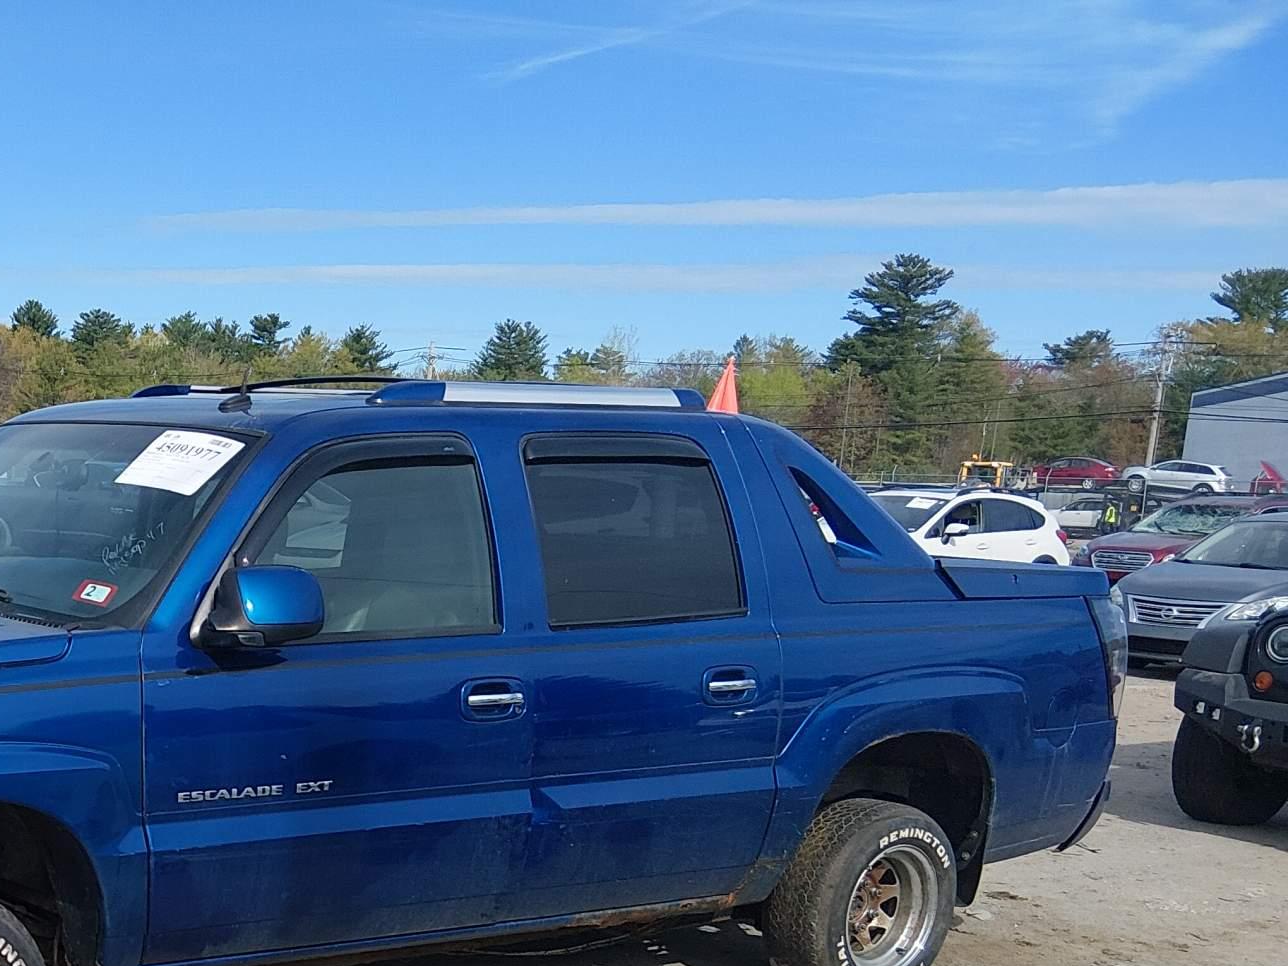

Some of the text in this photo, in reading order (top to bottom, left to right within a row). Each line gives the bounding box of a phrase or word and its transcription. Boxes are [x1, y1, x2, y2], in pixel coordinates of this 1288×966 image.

[178, 780, 333, 803] ESCALADE EXT
[879, 827, 951, 869] REMINGTON
